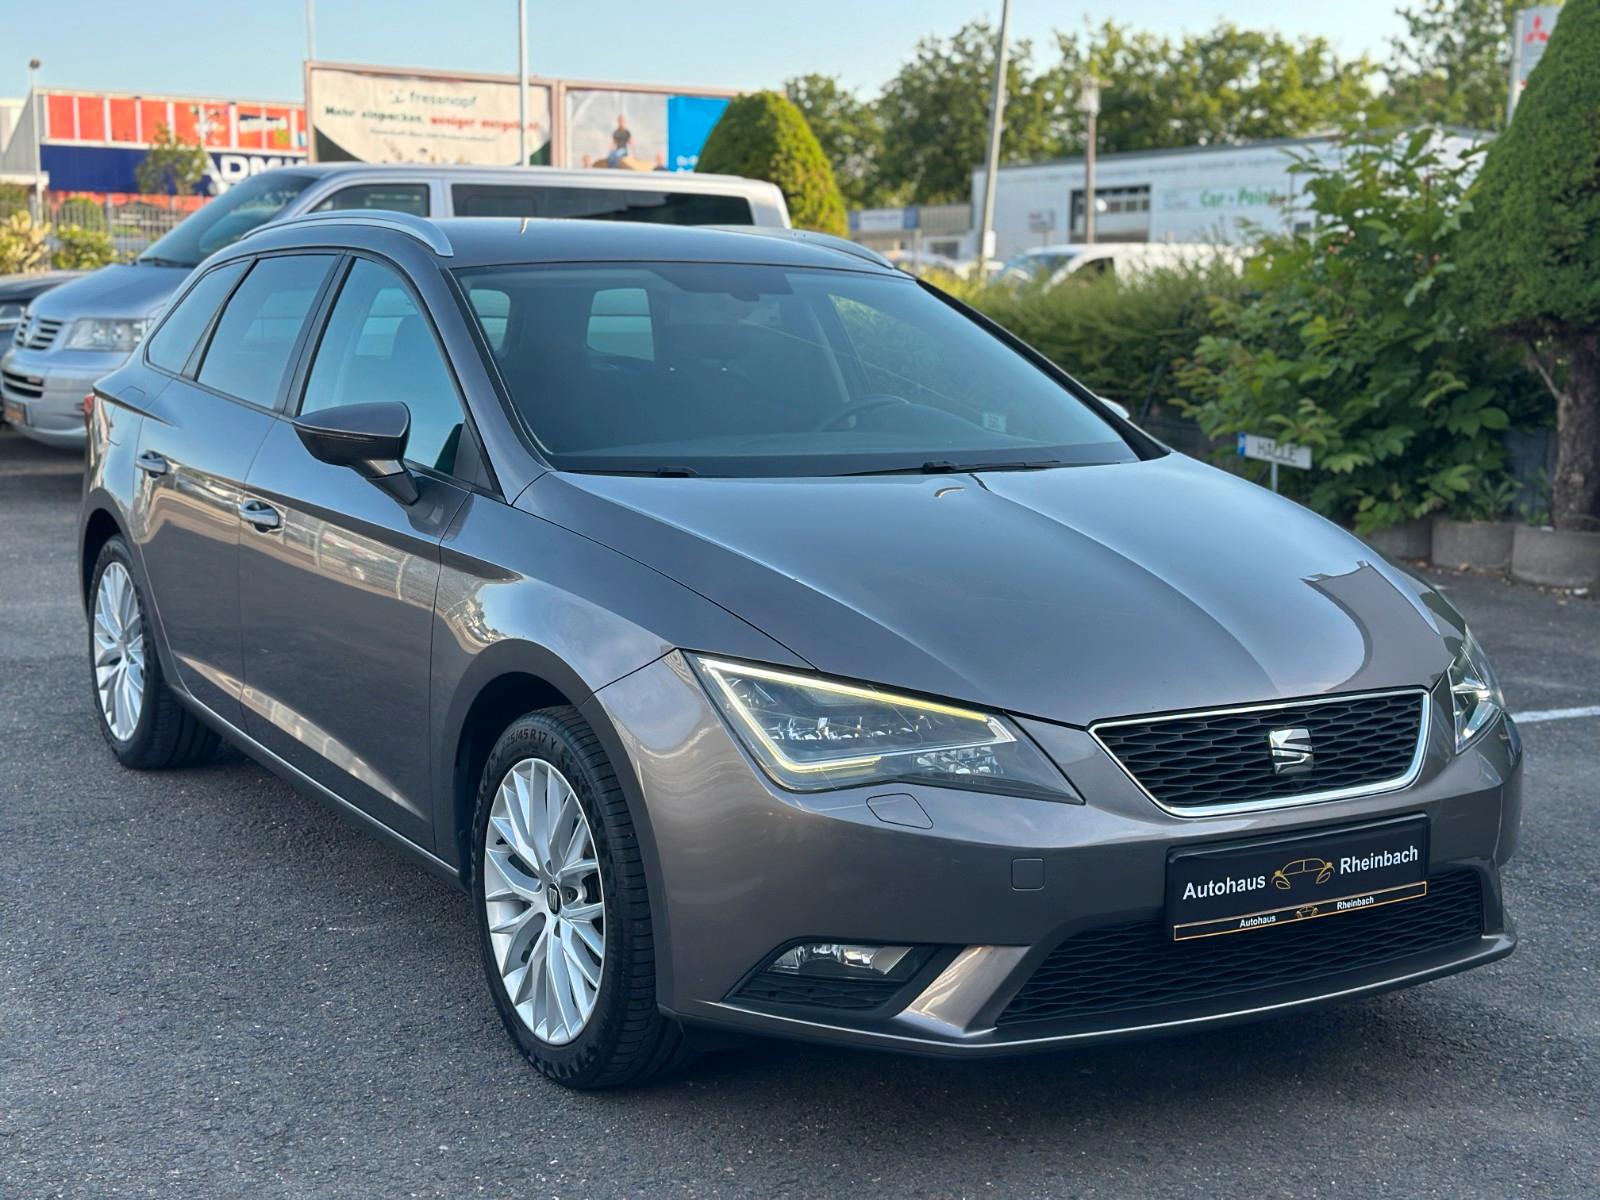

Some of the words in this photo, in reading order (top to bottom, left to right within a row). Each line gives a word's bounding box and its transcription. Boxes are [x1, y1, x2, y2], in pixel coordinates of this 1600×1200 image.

[430, 117, 475, 130] weniger
[537, 730, 548, 743] 17
[1182, 874, 1266, 900] Autohaus
[1340, 845, 1418, 875] Rheinbach
[1239, 914, 1277, 928] Autohaus
[1336, 896, 1375, 911] Rheinbach
